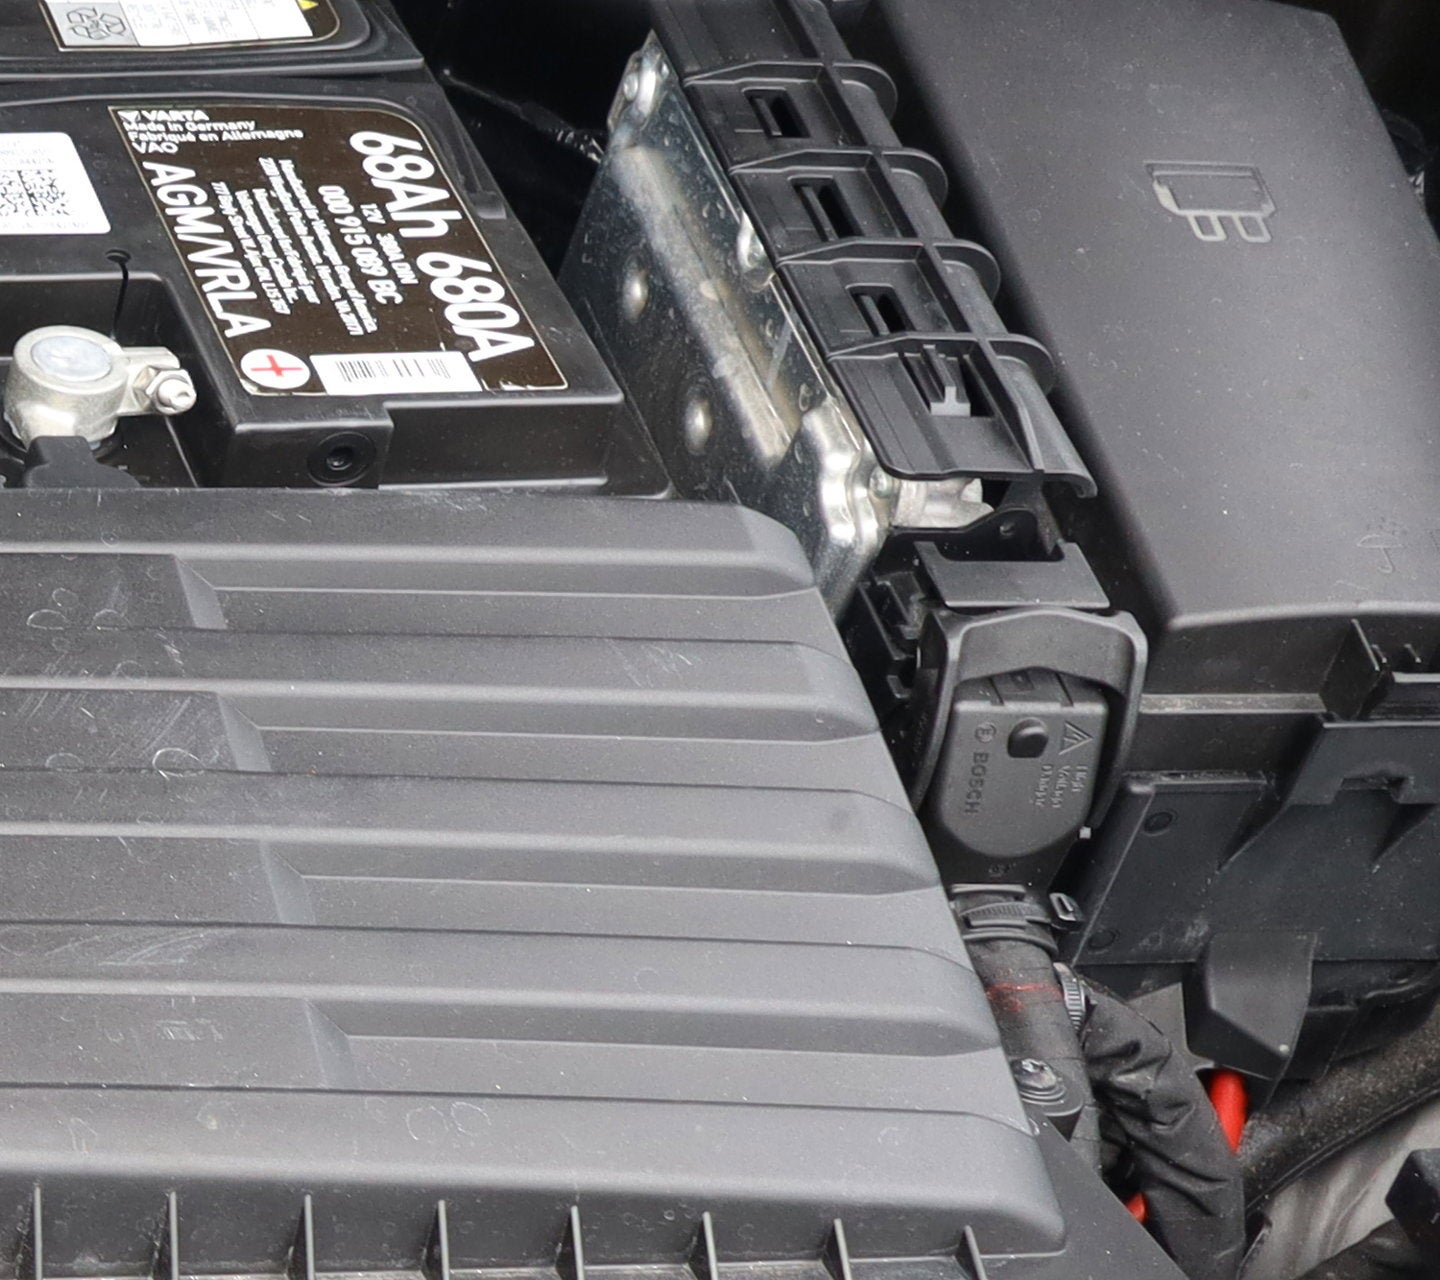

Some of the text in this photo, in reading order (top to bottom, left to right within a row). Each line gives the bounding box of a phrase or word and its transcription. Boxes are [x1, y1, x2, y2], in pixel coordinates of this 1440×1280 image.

[122, 121, 166, 132] Made
[185, 120, 256, 131] Germany
[140, 110, 210, 121] VARTA
[199, 132, 219, 141] en
[222, 129, 304, 141] Allemagne
[142, 161, 272, 338] AGM/VRLA
[318, 185, 403, 305] 000 915 089 BC
[349, 131, 535, 362] 68Ah 680A
[360, 203, 386, 224] 12V
[392, 262, 419, 285] DIN
